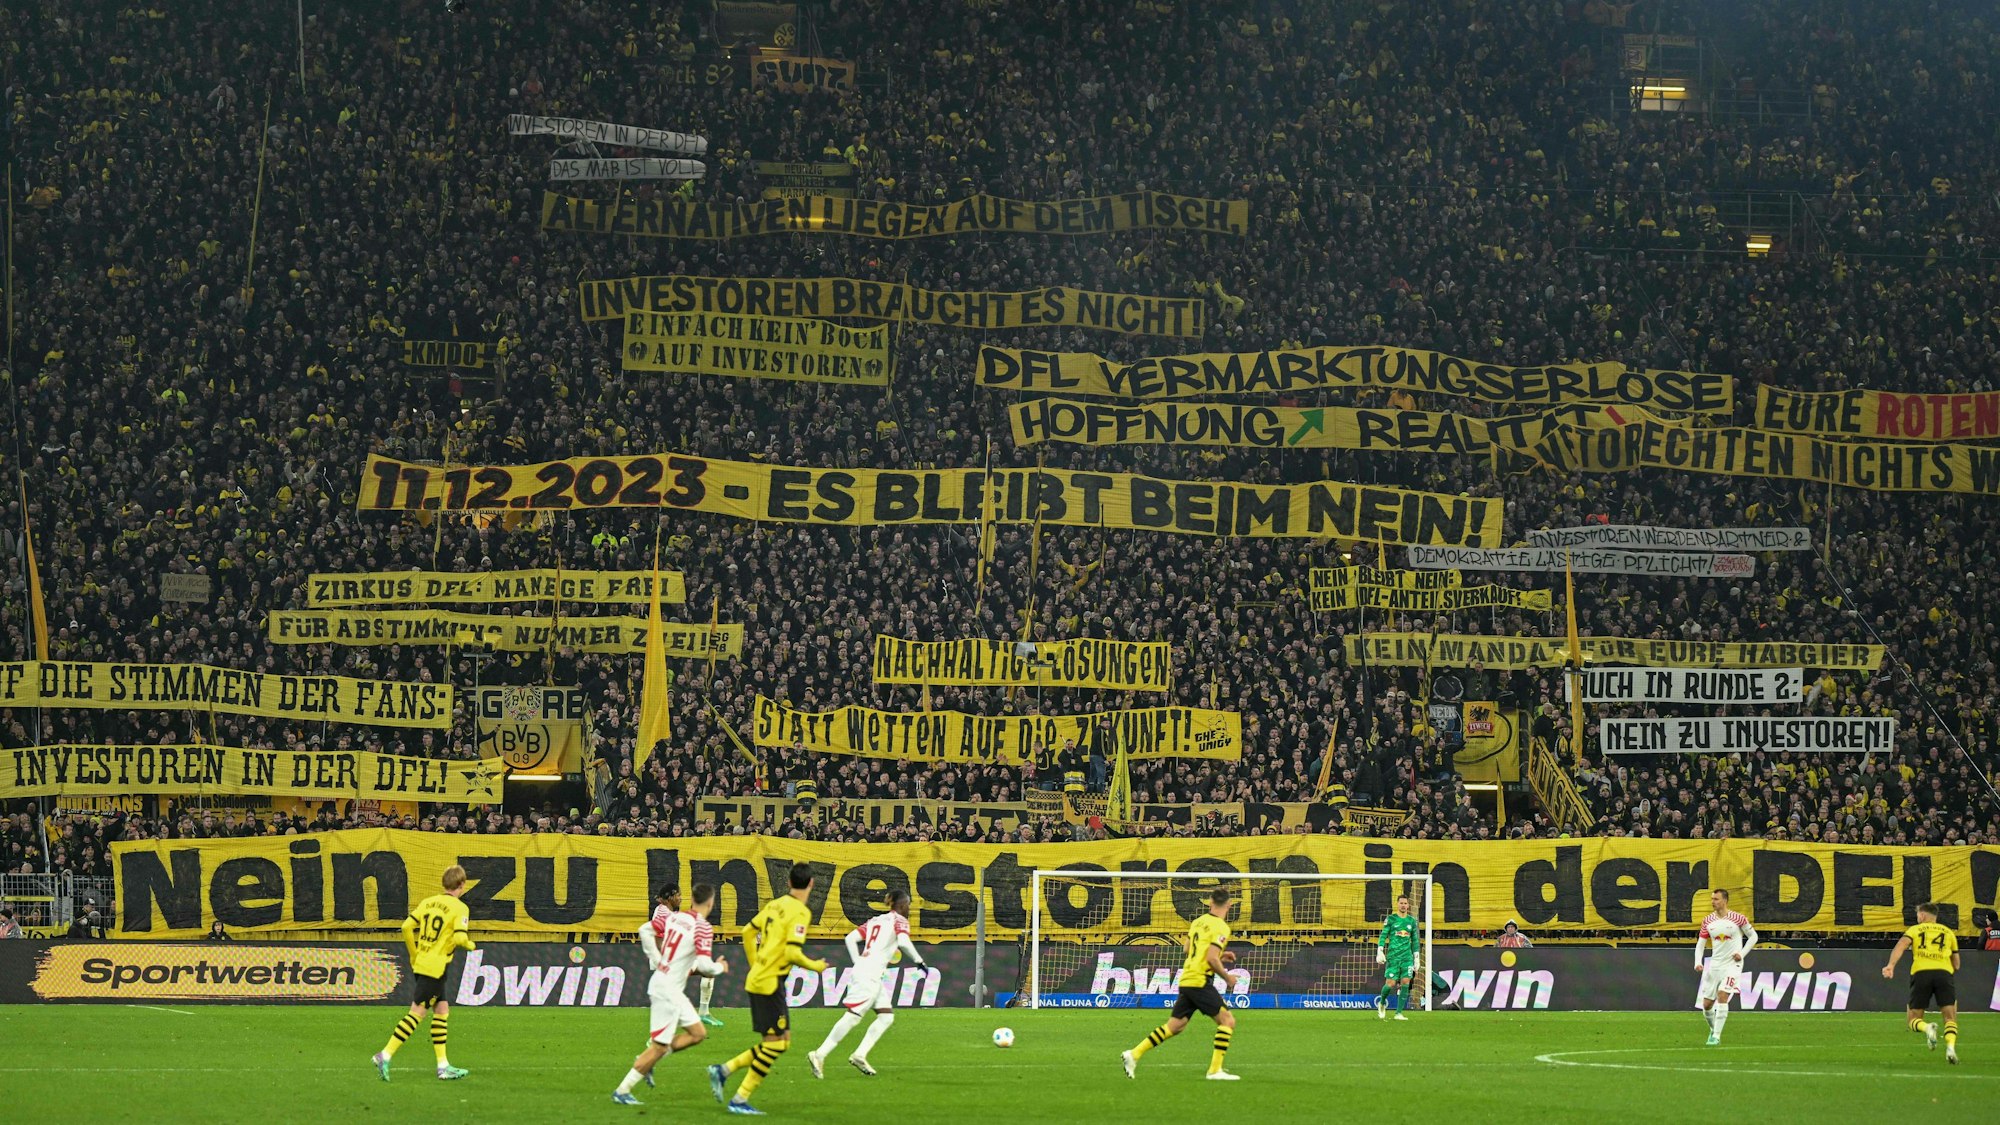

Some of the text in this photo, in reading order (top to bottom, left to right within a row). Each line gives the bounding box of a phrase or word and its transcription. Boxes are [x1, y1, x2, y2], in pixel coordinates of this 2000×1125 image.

[509, 115, 608, 141] INVESTOREN
[615, 125, 628, 143] IN
[636, 129, 669, 148] DER
[553, 161, 580, 178] DAS
[625, 160, 650, 176] IST
[547, 192, 1241, 237] ALTERNATIVEN LIEGEN AUF DEM TISCH,
[584, 277, 1204, 337] INVESTOREN BRAUCHT ES NICHT!
[629, 312, 743, 339] EINFACH
[821, 322, 884, 350] BOCK
[412, 342, 477, 366] KMDO
[653, 343, 863, 379] AUF INVESTOREN
[982, 347, 1728, 410] DFL VERMARKTUNGSERLÖSE
[1019, 399, 1286, 447] HOFFNUNG
[1764, 388, 2000, 439] EURE ROTEN
[1811, 437, 1953, 488] NICHTS
[373, 456, 708, 510] 11.12.2023
[767, 468, 856, 522] ES
[874, 472, 1113, 524] BLEIBT
[1131, 477, 1291, 536] BEIM
[1308, 484, 1487, 549] NEIN!
[315, 575, 669, 600] ZIRKUS DFL: MANEGE FREI
[1314, 569, 1348, 588] NEIN
[1358, 566, 1406, 586] BLEIBT
[1311, 589, 1346, 610] KEIN
[279, 617, 329, 638] FÜR
[515, 625, 621, 646] NUMMER
[633, 628, 706, 651] ZEI!
[1354, 637, 1426, 660] KEIN
[1650, 641, 1725, 663] EURE
[1738, 643, 1870, 667] HABGIER
[0, 664, 446, 719] F DIE STIMMEN DER FANS:
[1645, 671, 1672, 698] IN
[1684, 672, 1768, 700] RUNDE
[1775, 672, 1800, 699] 2:
[503, 724, 540, 754] BVB
[759, 700, 834, 747] STATT
[960, 715, 1007, 760] AUF
[1075, 709, 1191, 757] ZKUNFT!
[1607, 720, 1890, 750] NEIN ZU INVESTOREN!
[14, 747, 448, 794] INVESTOREN IN DER DFL!
[513, 753, 530, 764] 09
[121, 839, 1999, 934] Nein zu Investoren in der DFL!
[420, 914, 444, 943] 19
[1917, 931, 1946, 952] 14
[660, 928, 684, 963] 14
[81, 957, 356, 988] Sportwetten
[456, 945, 626, 1007] bwin
[1440, 950, 1555, 1010] win
[1725, 976, 1736, 988] 16
[1061, 999, 1092, 1008] IDUNA
[1303, 1000, 1372, 1008] SIGNAL IDUNA
